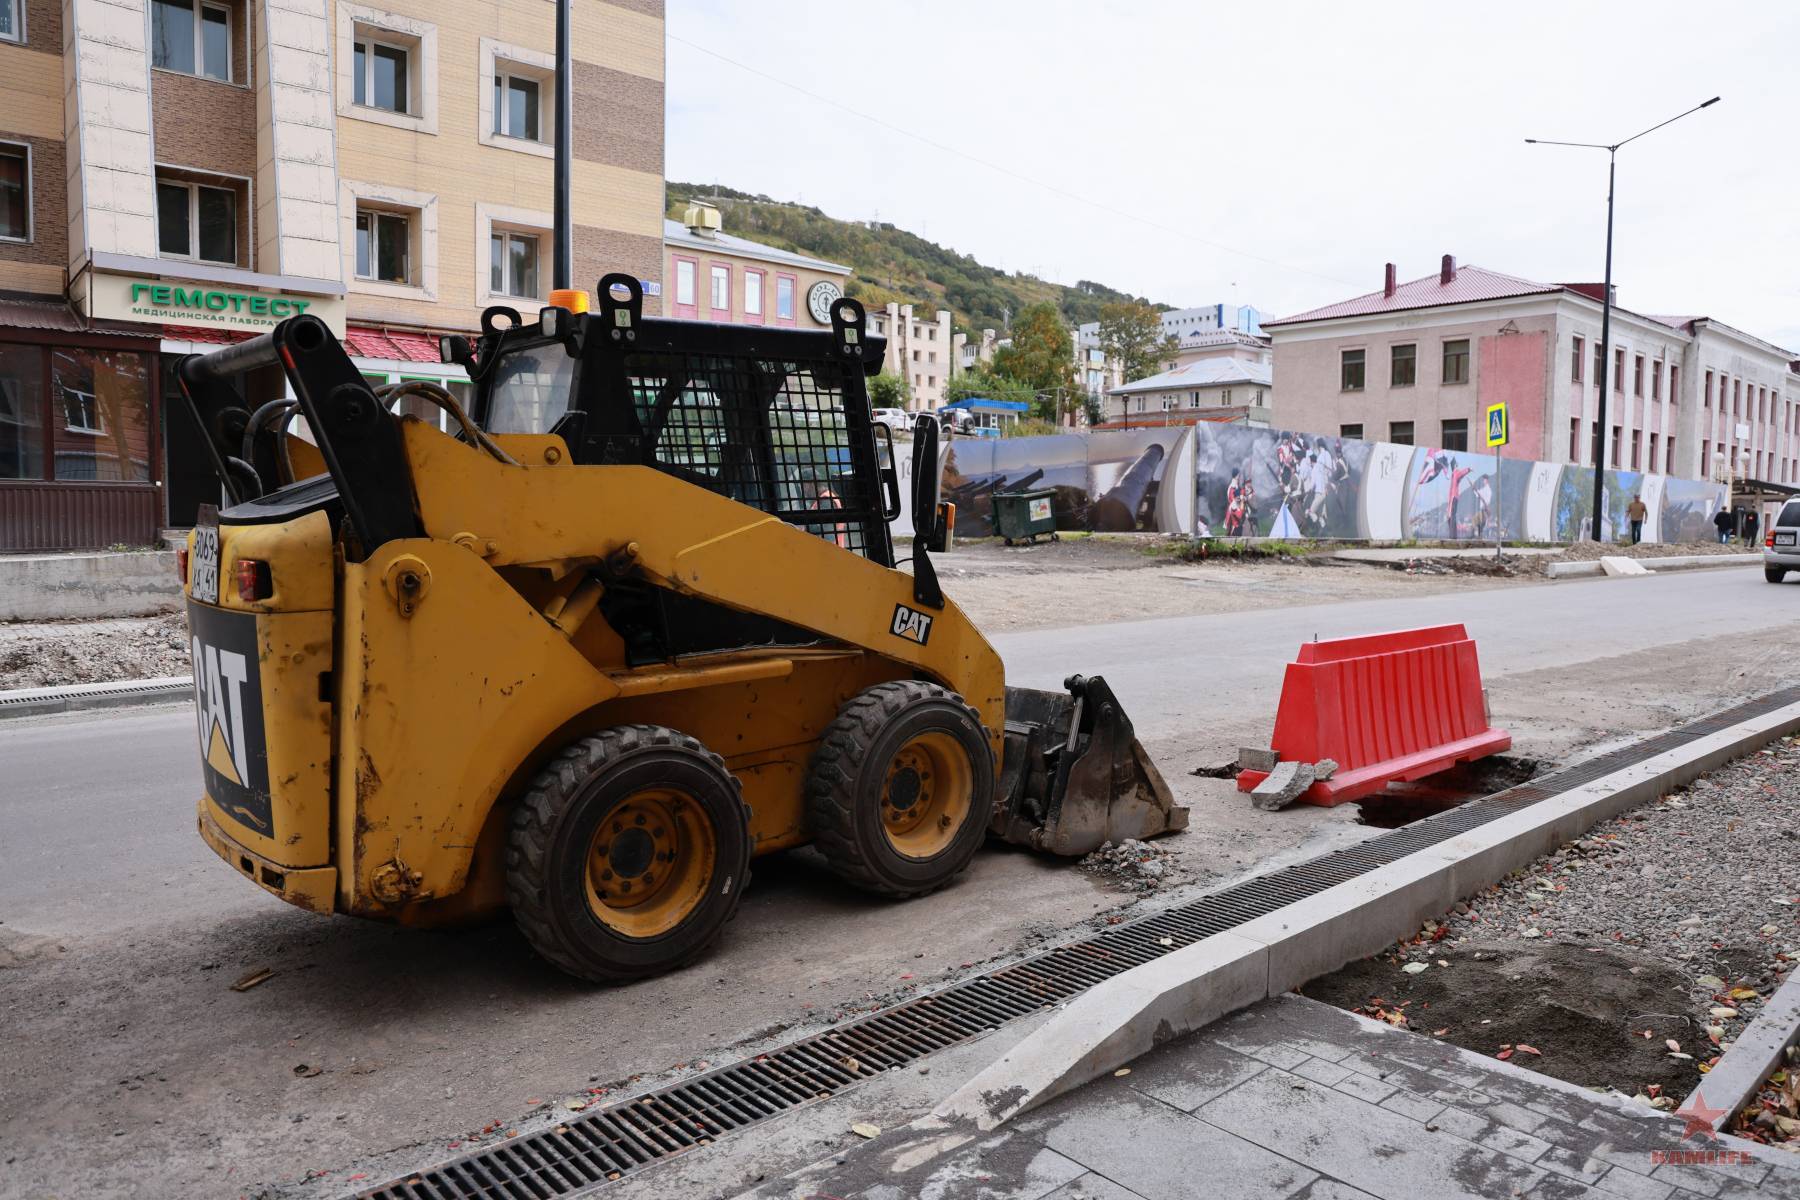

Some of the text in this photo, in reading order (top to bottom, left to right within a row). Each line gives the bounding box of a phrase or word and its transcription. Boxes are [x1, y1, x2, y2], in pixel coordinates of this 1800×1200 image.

[131, 283, 311, 316] ГЕМОТЕСТ
[132, 307, 279, 328] МЕДИЦИНСКАЯ ЛАБОРАТ
[205, 567, 215, 592] 41
[893, 606, 931, 643] CAT
[192, 634, 250, 789] CAT
